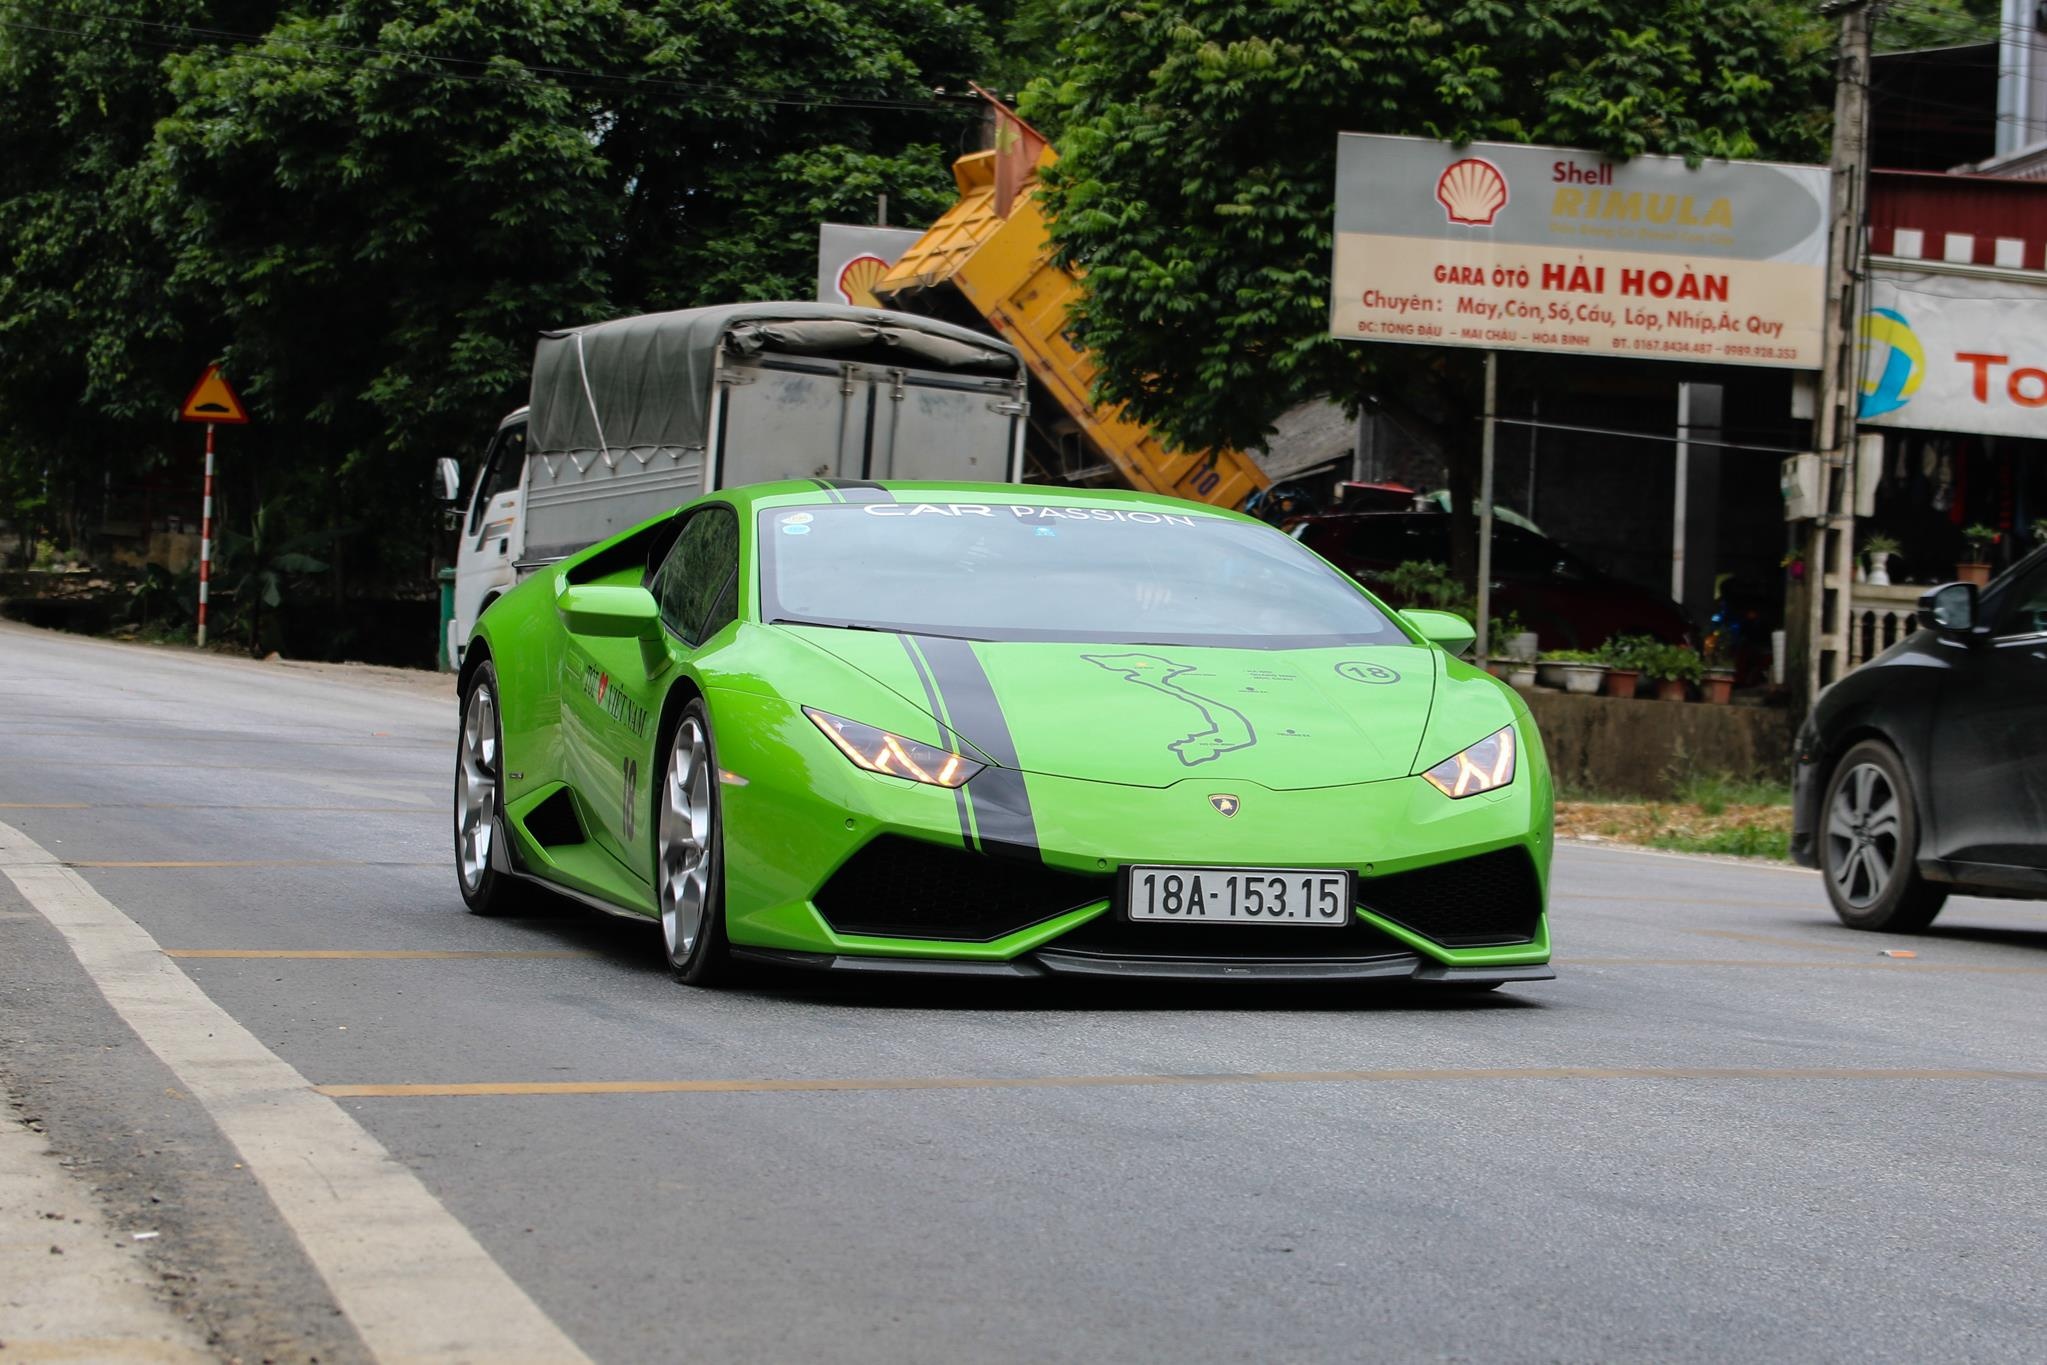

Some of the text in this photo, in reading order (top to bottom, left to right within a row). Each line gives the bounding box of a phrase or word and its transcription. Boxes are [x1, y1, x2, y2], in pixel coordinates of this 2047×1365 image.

[1553, 161, 1614, 186] Shell
[1551, 187, 1734, 229] RIMULA
[1434, 264, 1486, 286] GARA
[1541, 254, 1605, 294] HẢI
[1620, 263, 1729, 302] HOÀN
[1461, 328, 1482, 339] MAI
[1746, 315, 1784, 340] Quy
[1954, 352, 2047, 408] To
[1190, 463, 1220, 496] 10
[864, 503, 1197, 528] CAR PASSION
[1347, 666, 1391, 679] 18
[627, 698, 648, 739] NAM
[623, 756, 637, 842] 18
[1143, 873, 1340, 918] 18A-153.15
